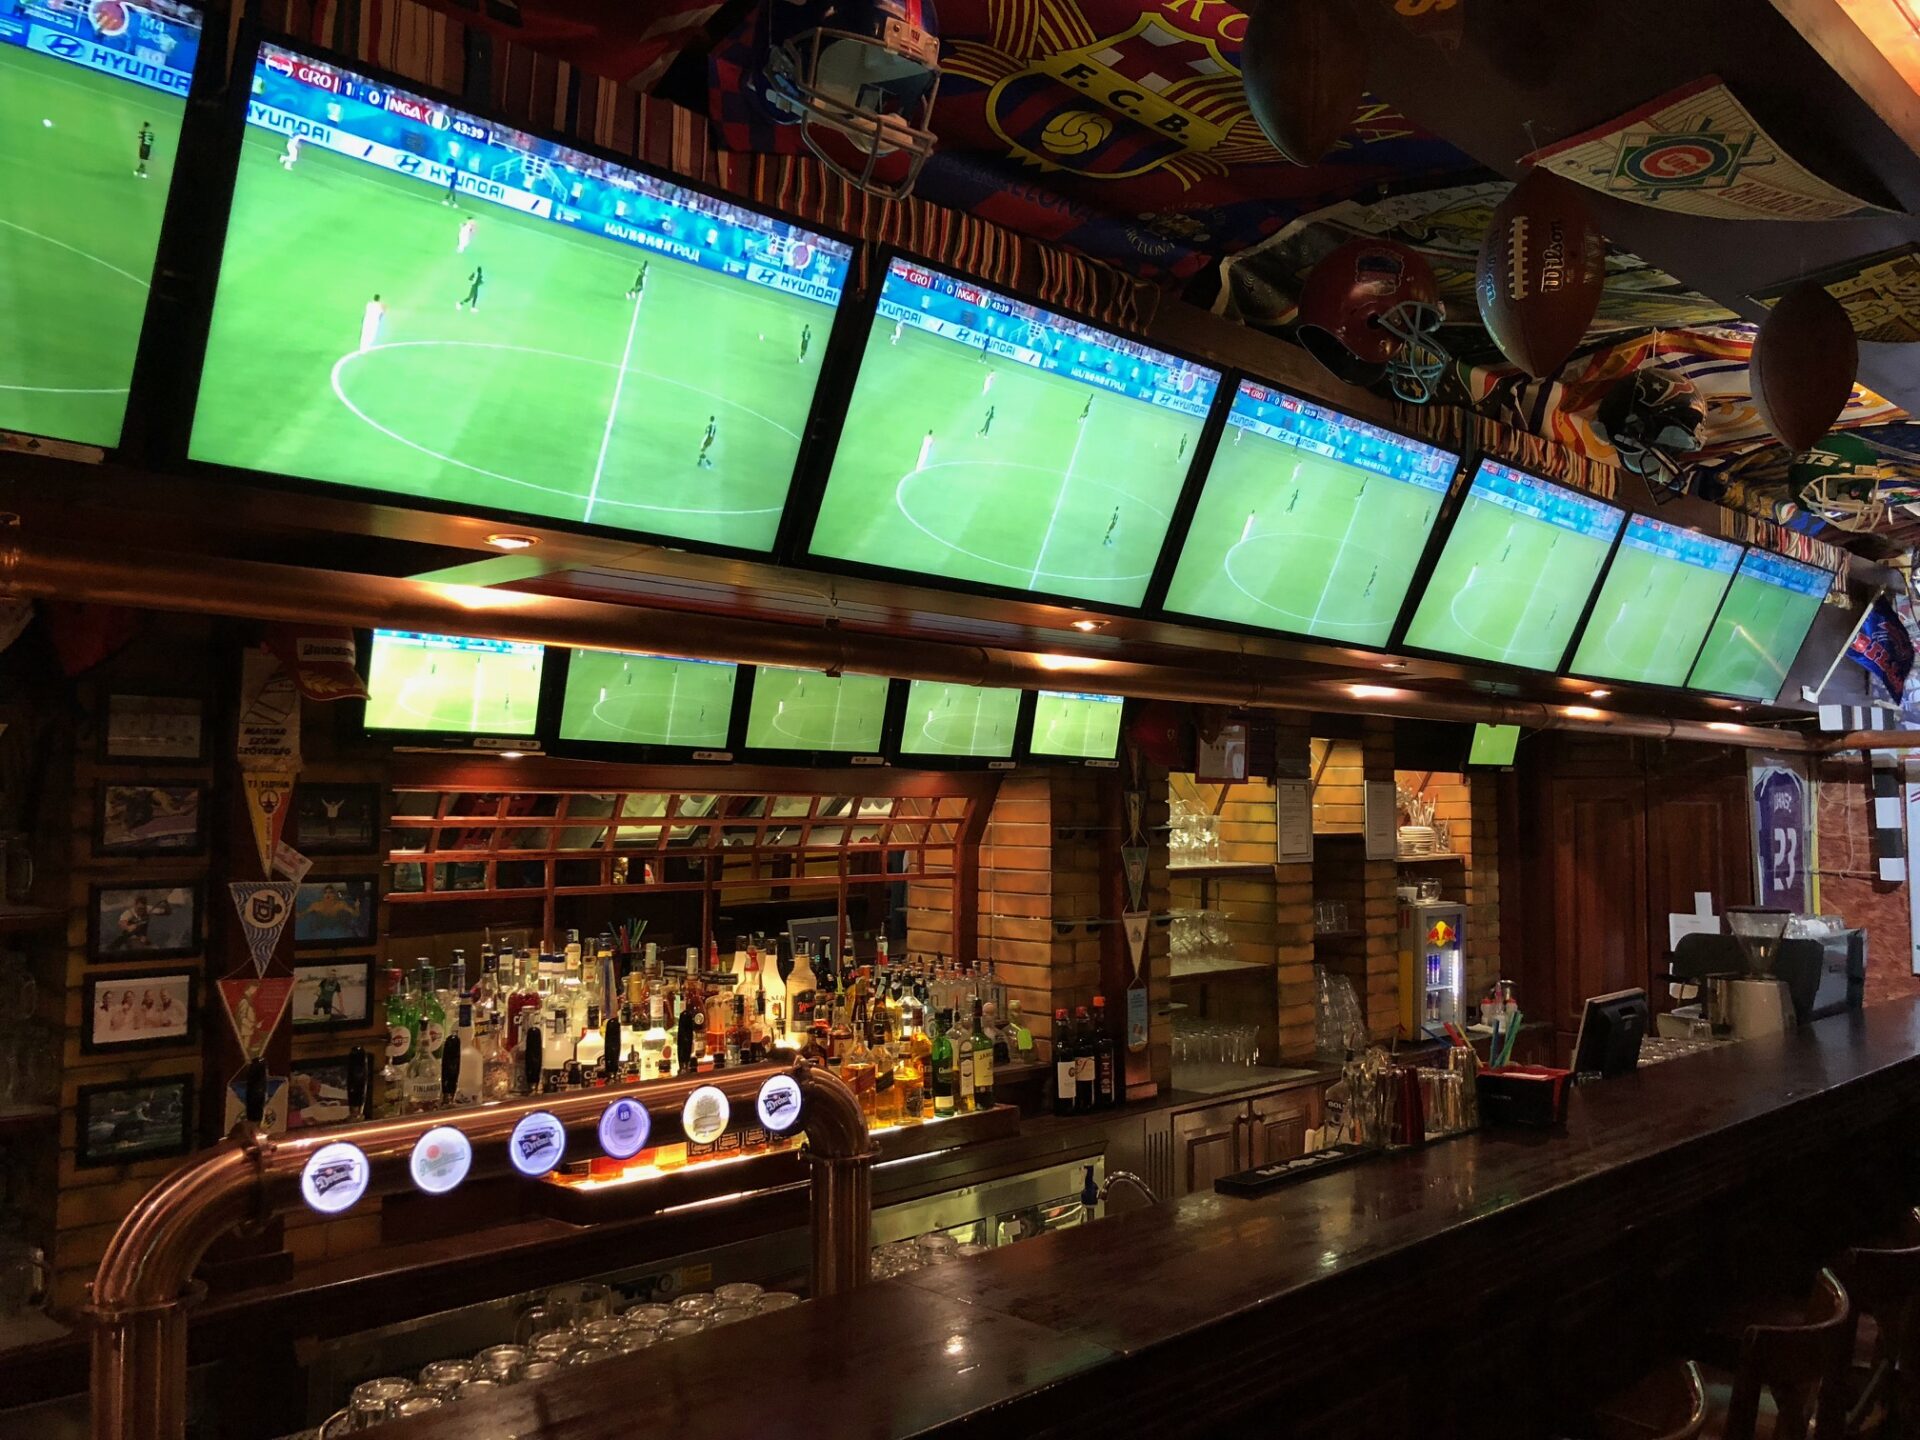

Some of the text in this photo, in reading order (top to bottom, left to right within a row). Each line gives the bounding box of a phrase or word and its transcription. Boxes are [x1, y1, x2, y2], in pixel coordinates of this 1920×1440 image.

[91, 48, 191, 91] HYUNDA
[298, 66, 332, 89] CRO
[389, 97, 422, 120] NGA
[452, 120, 485, 139] 43:39
[780, 276, 837, 302] HYUNDAI
[909, 273, 929, 286] CRO
[957, 289, 976, 303] NGA
[878, 302, 922, 323] YUNDAI
[1172, 399, 1208, 416] HYUNDAI
[1773, 827, 1797, 891] 23
